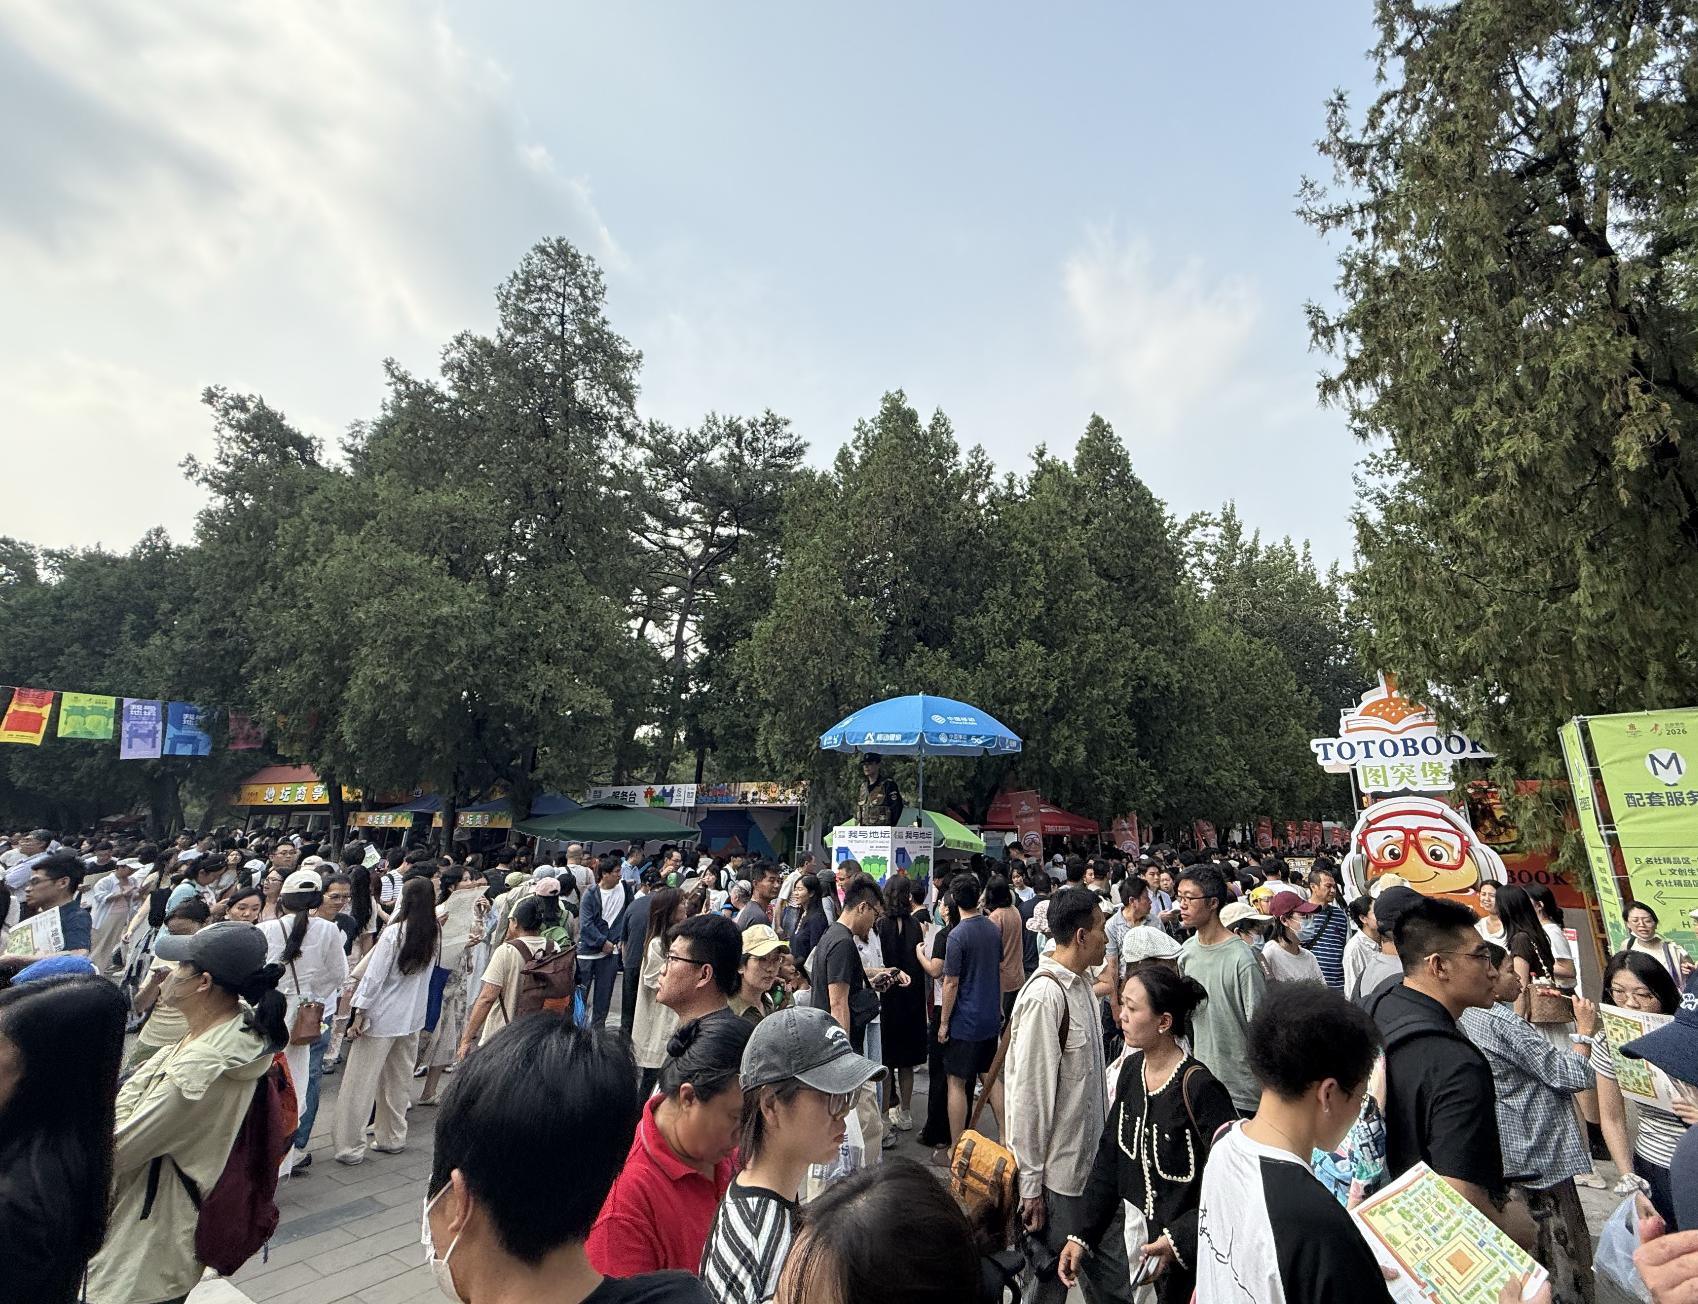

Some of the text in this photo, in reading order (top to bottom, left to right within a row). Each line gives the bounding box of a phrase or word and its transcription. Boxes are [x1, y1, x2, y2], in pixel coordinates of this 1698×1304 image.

[1666, 728, 1687, 736] 2026
[1649, 752, 1683, 776] M
[1361, 761, 1450, 788] 图突堡
[263, 785, 325, 803] 地坛商亭
[848, 830, 891, 839] 我与地坛
[905, 830, 932, 839] 我与地坛
[1645, 879, 1653, 887] A
